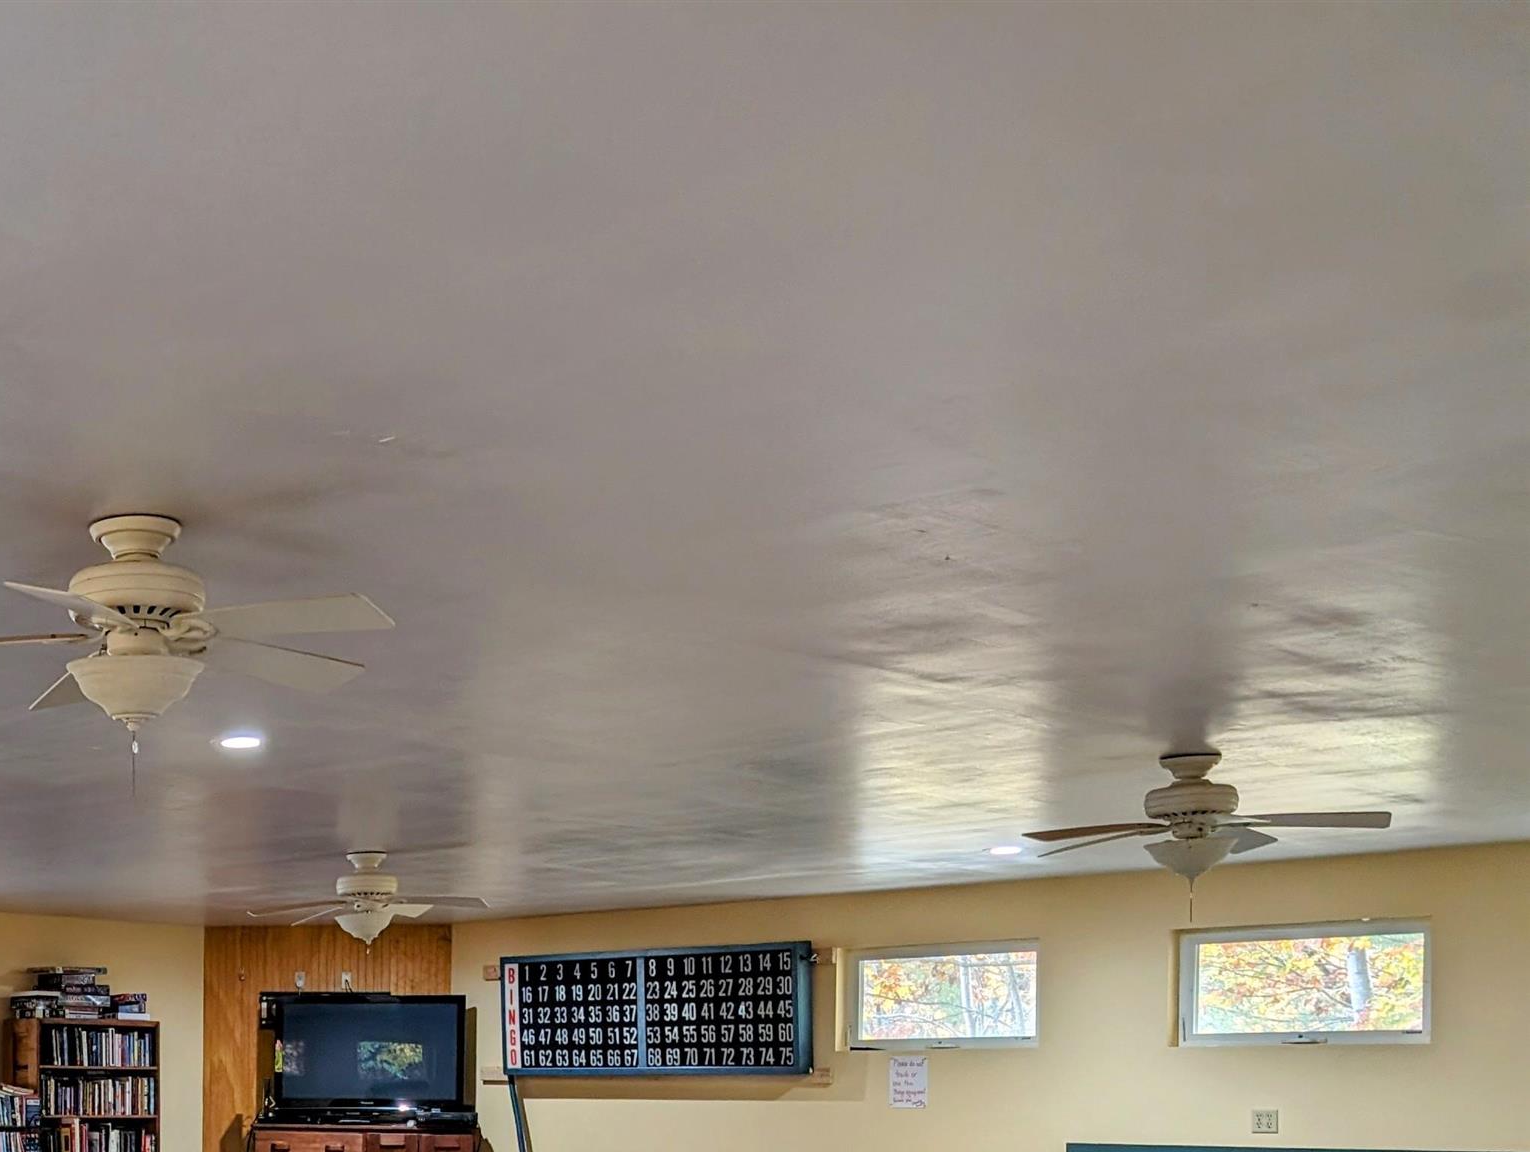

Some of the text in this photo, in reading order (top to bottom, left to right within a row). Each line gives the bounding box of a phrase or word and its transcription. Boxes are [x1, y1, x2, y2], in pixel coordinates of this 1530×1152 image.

[525, 953, 790, 981] 1 2 3 4 5 6 7 8 9 10 11 12 13 14 15
[522, 976, 791, 1003] 16 17 18 19 20 21 22 23 24 25 26 27 28 29 30
[523, 1000, 793, 1024] 31 32 33 34 35 36 37 38 39 40 41 42 43 44 45
[522, 1023, 793, 1045] 46 47 48 49 50 51 52 53 54 55 56 57 58 59 60
[524, 1048, 793, 1066] 61 62 63 64 65 66 67 68 69 70 71 72 73 74 75
